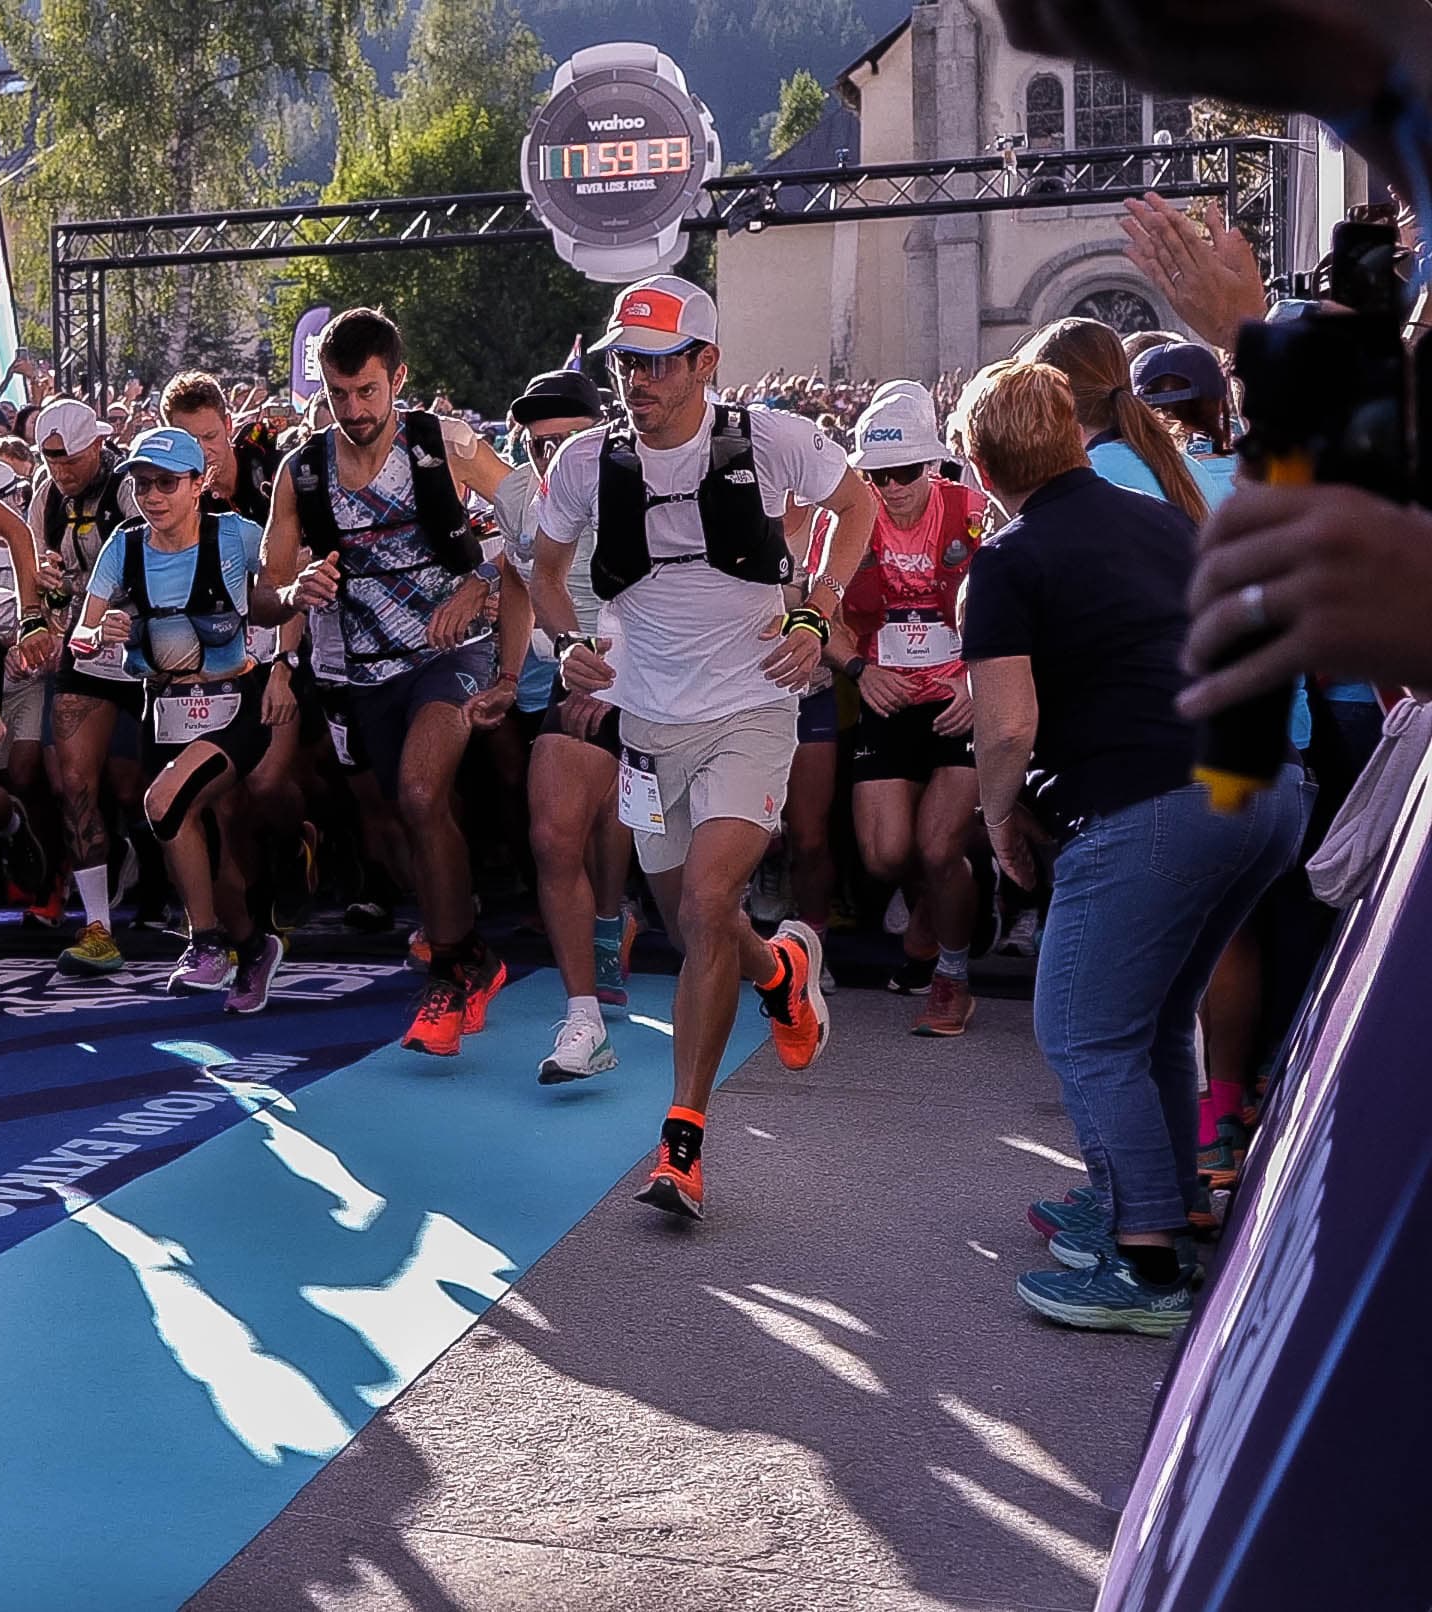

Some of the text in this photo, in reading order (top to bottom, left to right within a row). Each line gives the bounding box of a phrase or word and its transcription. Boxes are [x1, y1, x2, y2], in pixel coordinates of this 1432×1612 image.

[587, 114, 646, 132] wahoo
[864, 429, 903, 443] HOKA
[898, 624, 932, 633] UTMB
[907, 633, 926, 645] 77
[176, 698, 214, 706] UTMB
[187, 707, 209, 720] 40
[622, 776, 632, 795] 16
[1150, 1287, 1189, 1313] HOKA
